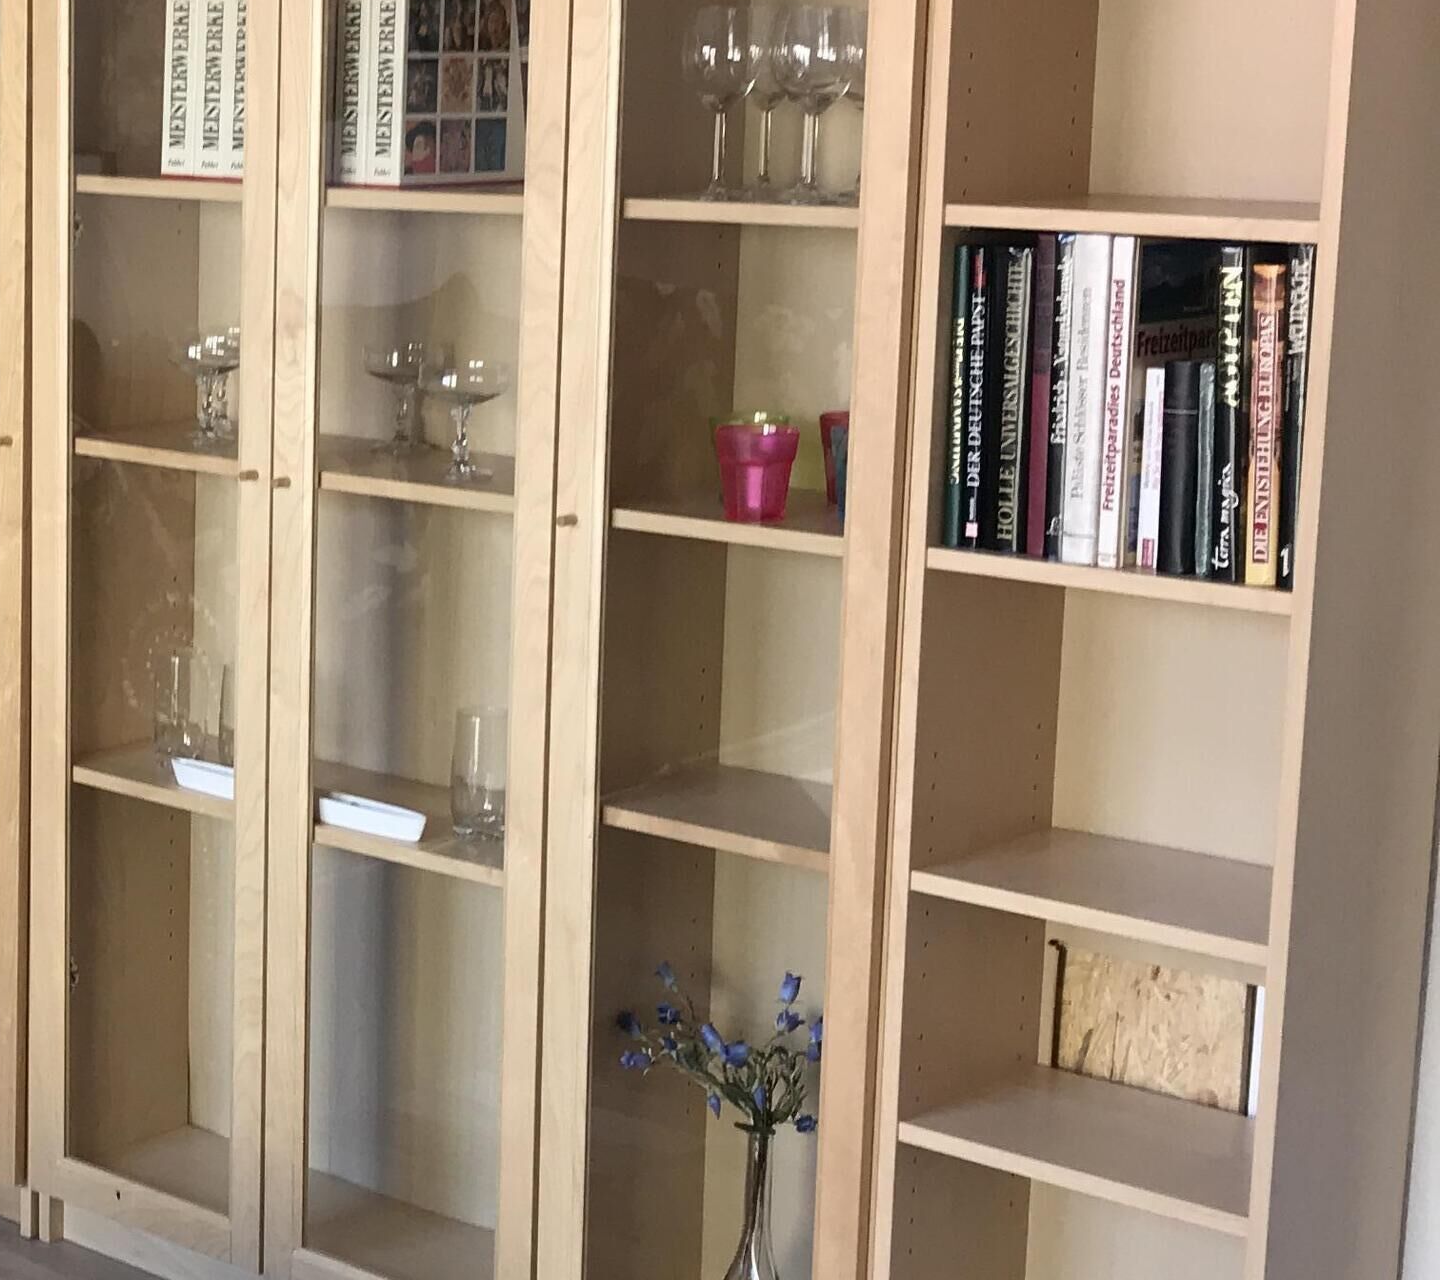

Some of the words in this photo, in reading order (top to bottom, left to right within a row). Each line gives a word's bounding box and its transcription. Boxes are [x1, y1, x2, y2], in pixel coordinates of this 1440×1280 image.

[169, 0, 190, 151] MEISTERWERKE
[202, 0, 224, 152] MEISTERWERKE
[340, 0, 362, 157] MEISTERWERKE
[375, 0, 397, 158] MEISTERWERKE
[970, 293, 986, 345] PAPST
[1000, 261, 1025, 460] UNIVERSALGESCHICHTE
[1108, 279, 1126, 379] Deutschland
[1136, 324, 1217, 358] Freizeitpar
[1257, 314, 1275, 396] EUROPAS
[967, 350, 983, 449] DEUTSCHE
[1102, 385, 1123, 512] Freizeitparadies
[966, 451, 981, 488] DER
[996, 466, 1016, 540] HOLLE
[1252, 401, 1273, 524] ENTSTEHUNG
[1251, 528, 1269, 561] DIE
